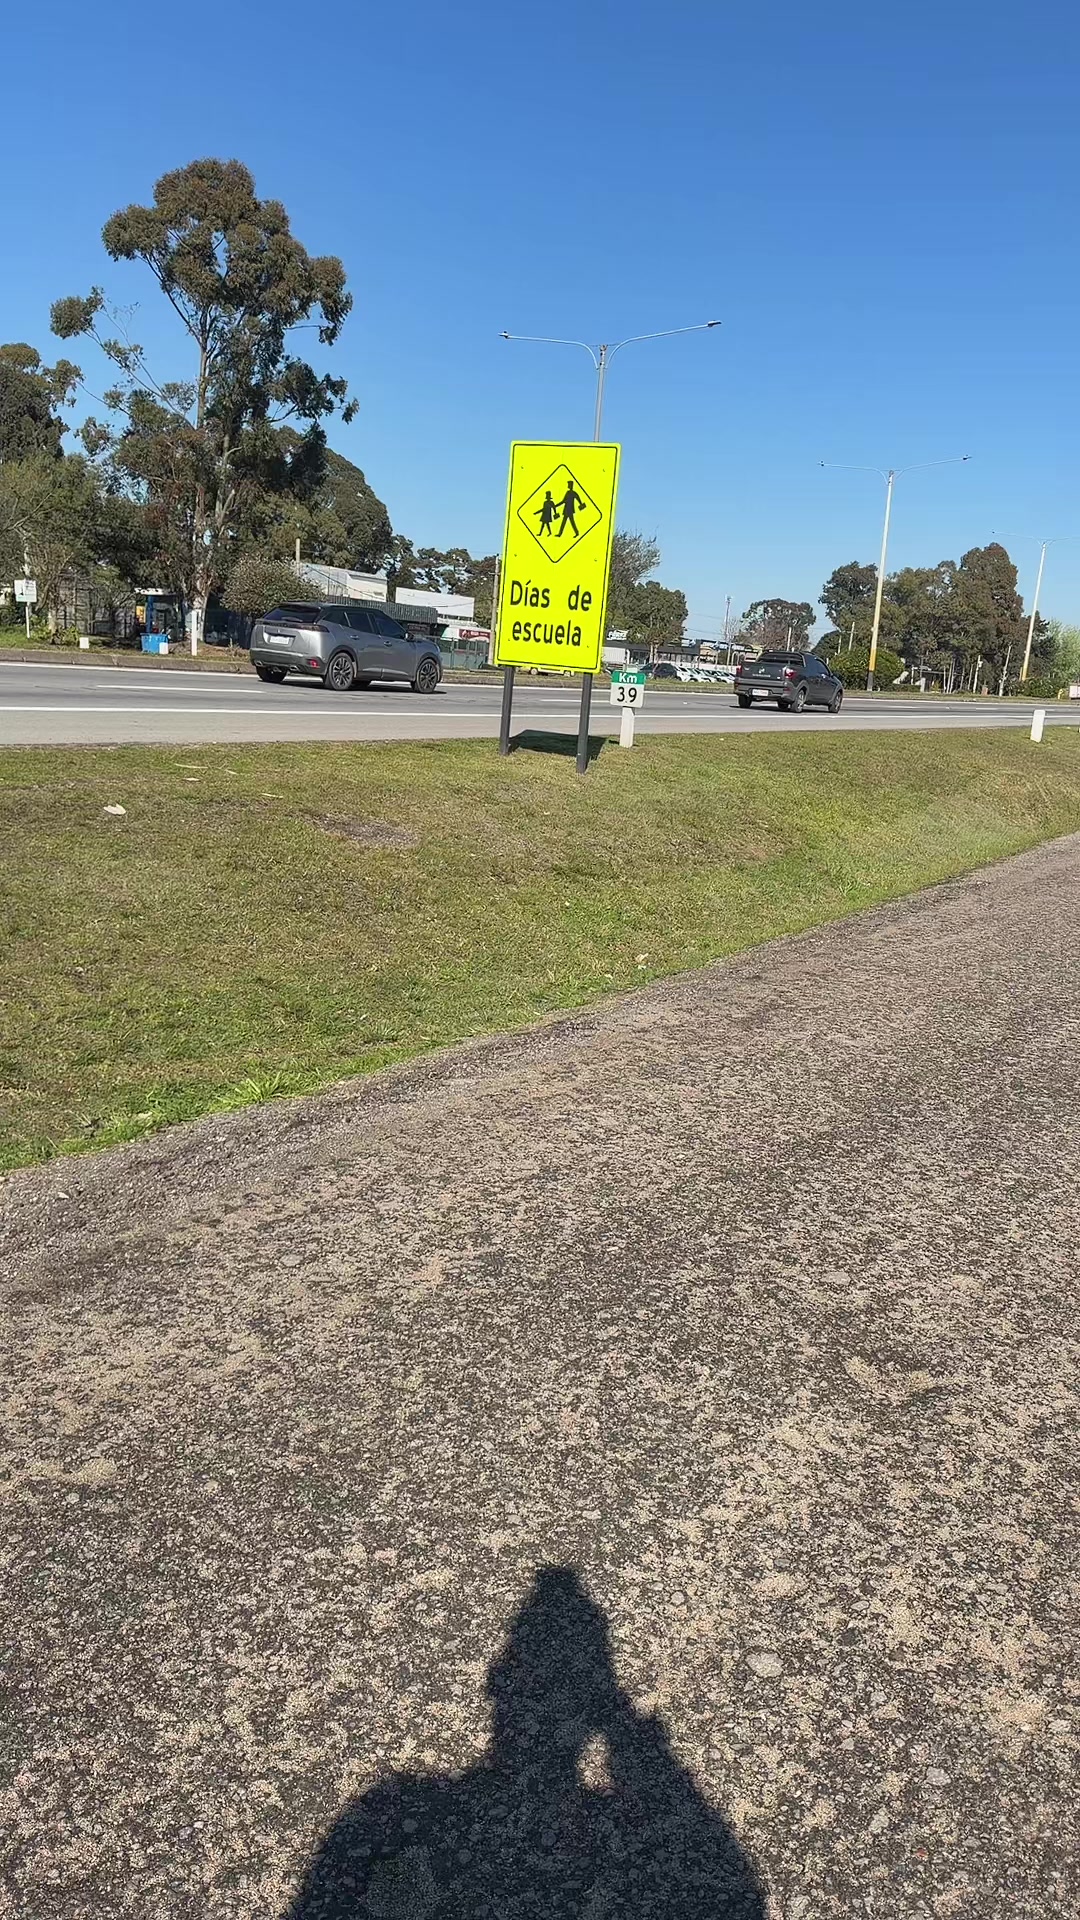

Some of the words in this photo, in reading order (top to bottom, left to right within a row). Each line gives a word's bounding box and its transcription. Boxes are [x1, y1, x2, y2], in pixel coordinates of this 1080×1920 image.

[510, 579, 550, 608] Días
[568, 584, 592, 612] de
[512, 620, 582, 647] escuela
[618, 672, 638, 684] Km
[616, 686, 638, 703] 39
